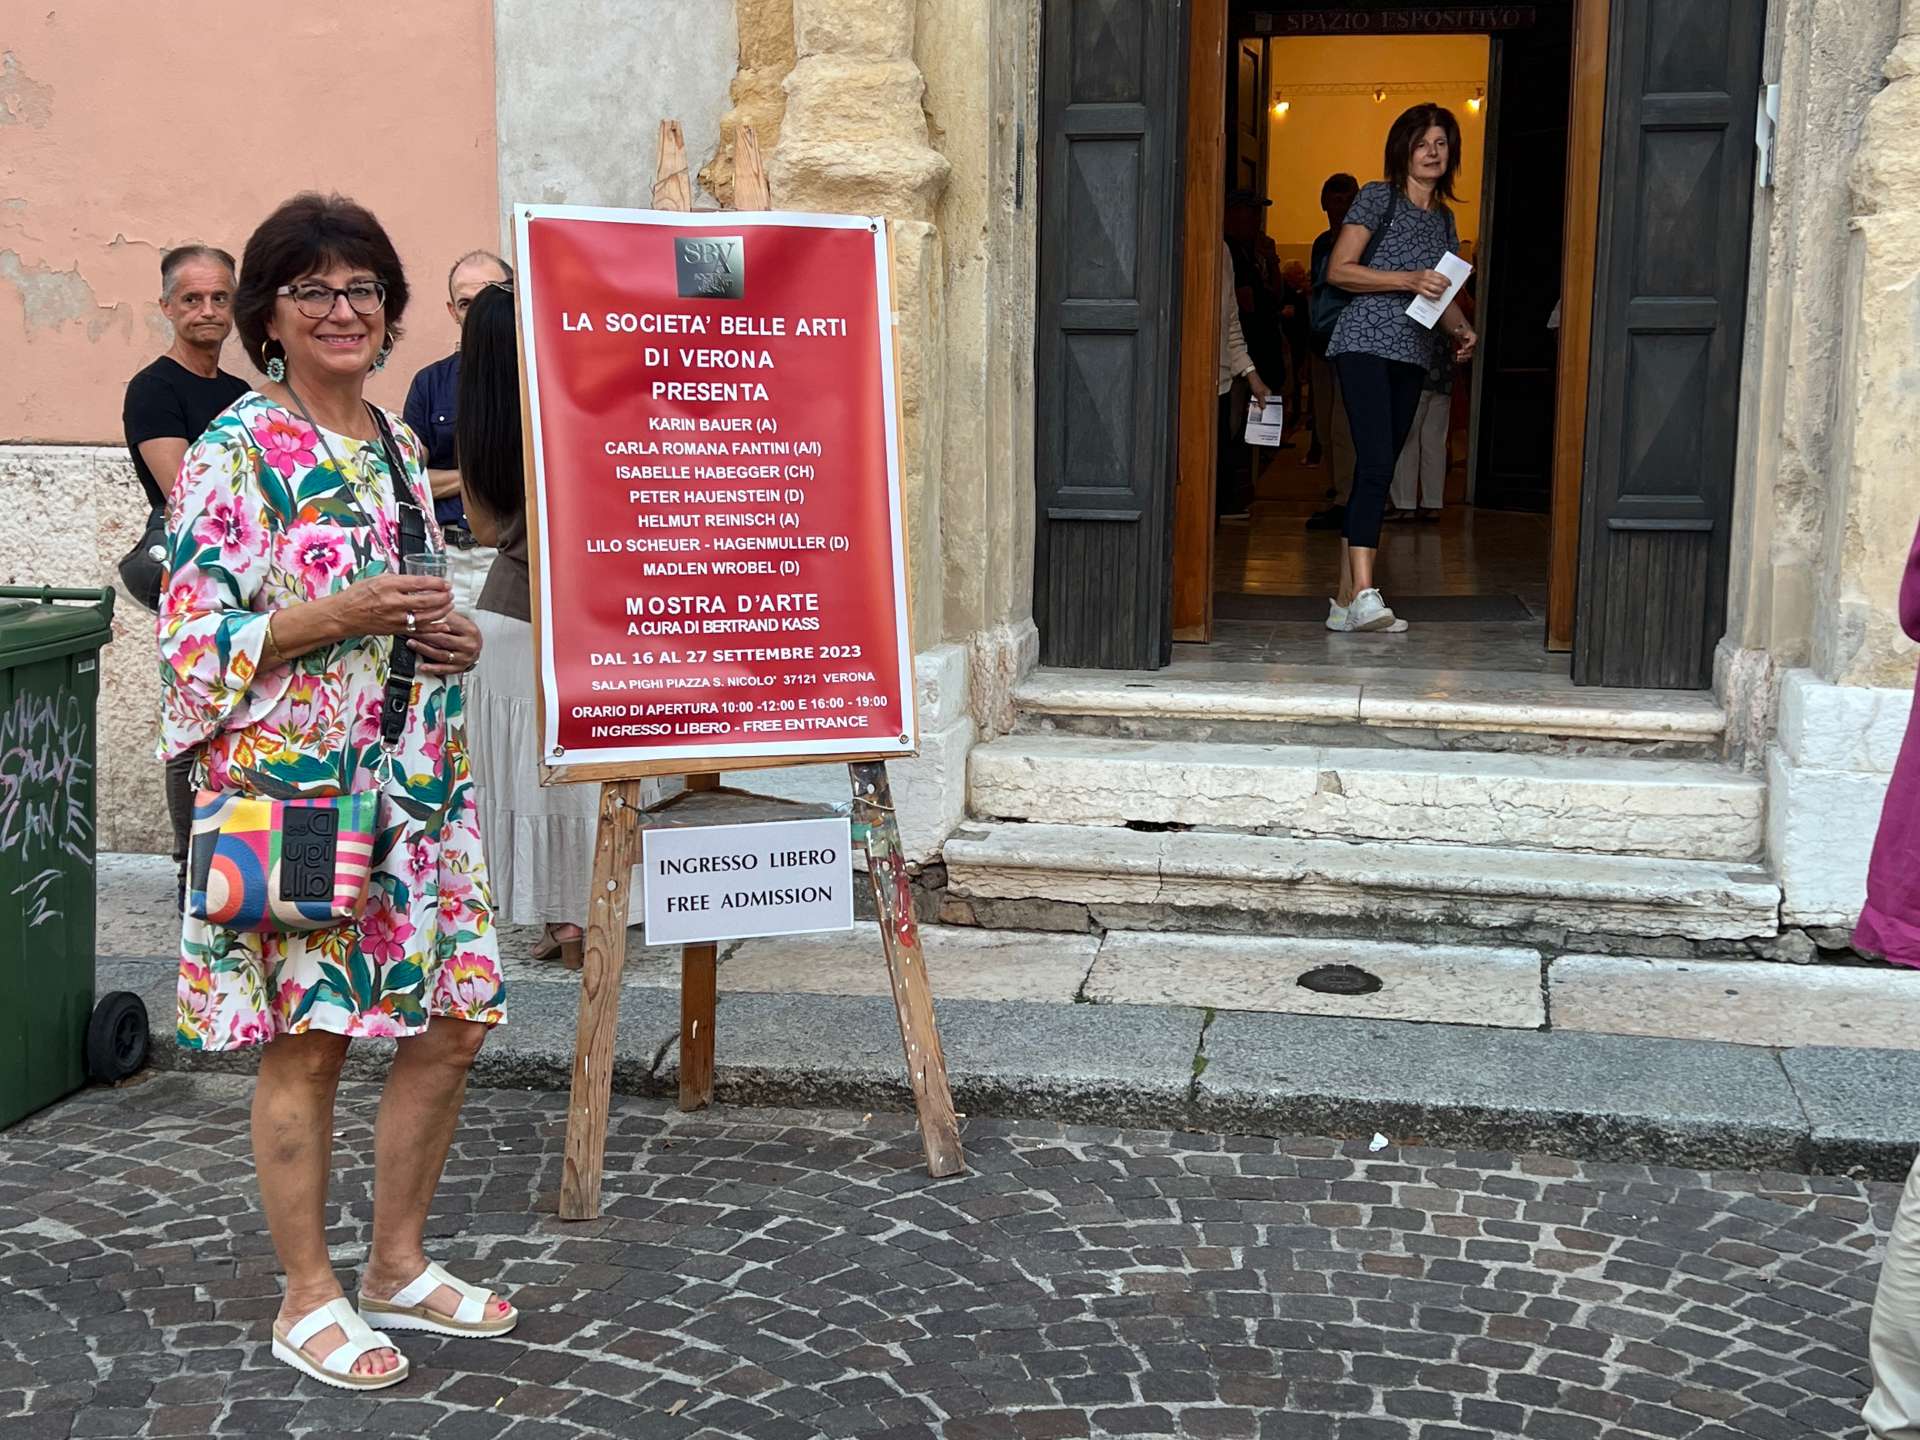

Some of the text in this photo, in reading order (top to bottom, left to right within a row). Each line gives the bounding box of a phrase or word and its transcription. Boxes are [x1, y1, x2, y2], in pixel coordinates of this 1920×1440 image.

[1287, 9, 1520, 31] SPAZIO ESPOSITIVO
[562, 312, 848, 337] LA SOCIETA' BELLE ARTI
[644, 347, 774, 369] DI VERONA
[652, 382, 769, 401] PRESENTA
[649, 417, 777, 433] KARIN BAUER (A)
[604, 441, 822, 456] CARLA ROMANA FANTINI (A/I)
[615, 465, 815, 481] ISABELLE HABEGGER (CH)
[629, 489, 805, 505] PETER HAUENSTEIN (D)
[637, 513, 800, 529] HELMUT REINISCH (A)
[586, 539, 623, 553] LILO
[626, 538, 700, 552] SCHEUER
[713, 536, 825, 551] HAGENMULLER
[829, 536, 849, 552] (D)
[643, 560, 800, 576] MADLEN WROBEL (D)
[625, 593, 819, 616] MOSTRA D'ARTE
[627, 617, 820, 636] A CURA DI BERTRAND KASS
[590, 645, 862, 666] DAL 16 AL 27 SETTEMBRE 2023
[591, 671, 876, 691] SALA PIGHI PIAZZA S. NICOLO' 37121 VERONA
[572, 704, 626, 719] ORARIO
[630, 704, 644, 716] DI
[646, 702, 719, 716] APERTURA
[722, 701, 754, 713] 10:00
[799, 699, 808, 711] E
[811, 697, 844, 710] 16:00
[856, 695, 888, 707] 19:00
[591, 723, 672, 738] INGRESSO
[675, 721, 731, 735] LIBERO
[743, 719, 783, 733] FREE
[785, 715, 868, 731] ENTRANCE
[660, 848, 837, 876] INGRESSO LIBERO
[667, 886, 832, 913] FREE ADMISSION
